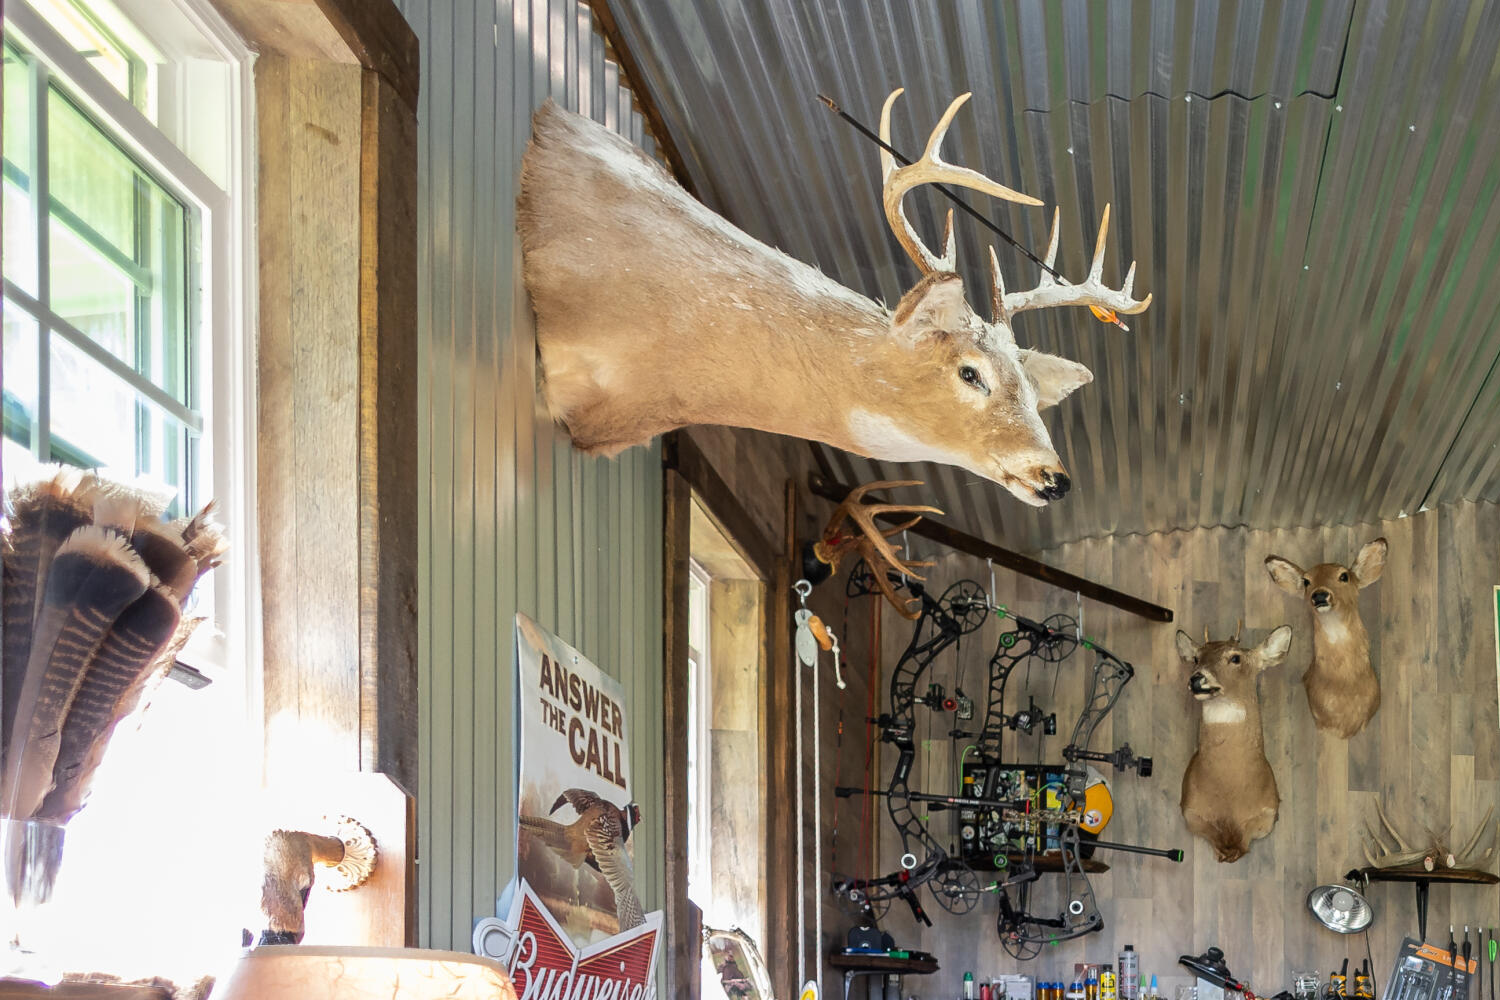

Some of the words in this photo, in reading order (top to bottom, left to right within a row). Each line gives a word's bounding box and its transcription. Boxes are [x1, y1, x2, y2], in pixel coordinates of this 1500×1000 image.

[539, 653, 623, 740] ANSWER
[539, 698, 567, 736] THE
[568, 717, 627, 791] CALL
